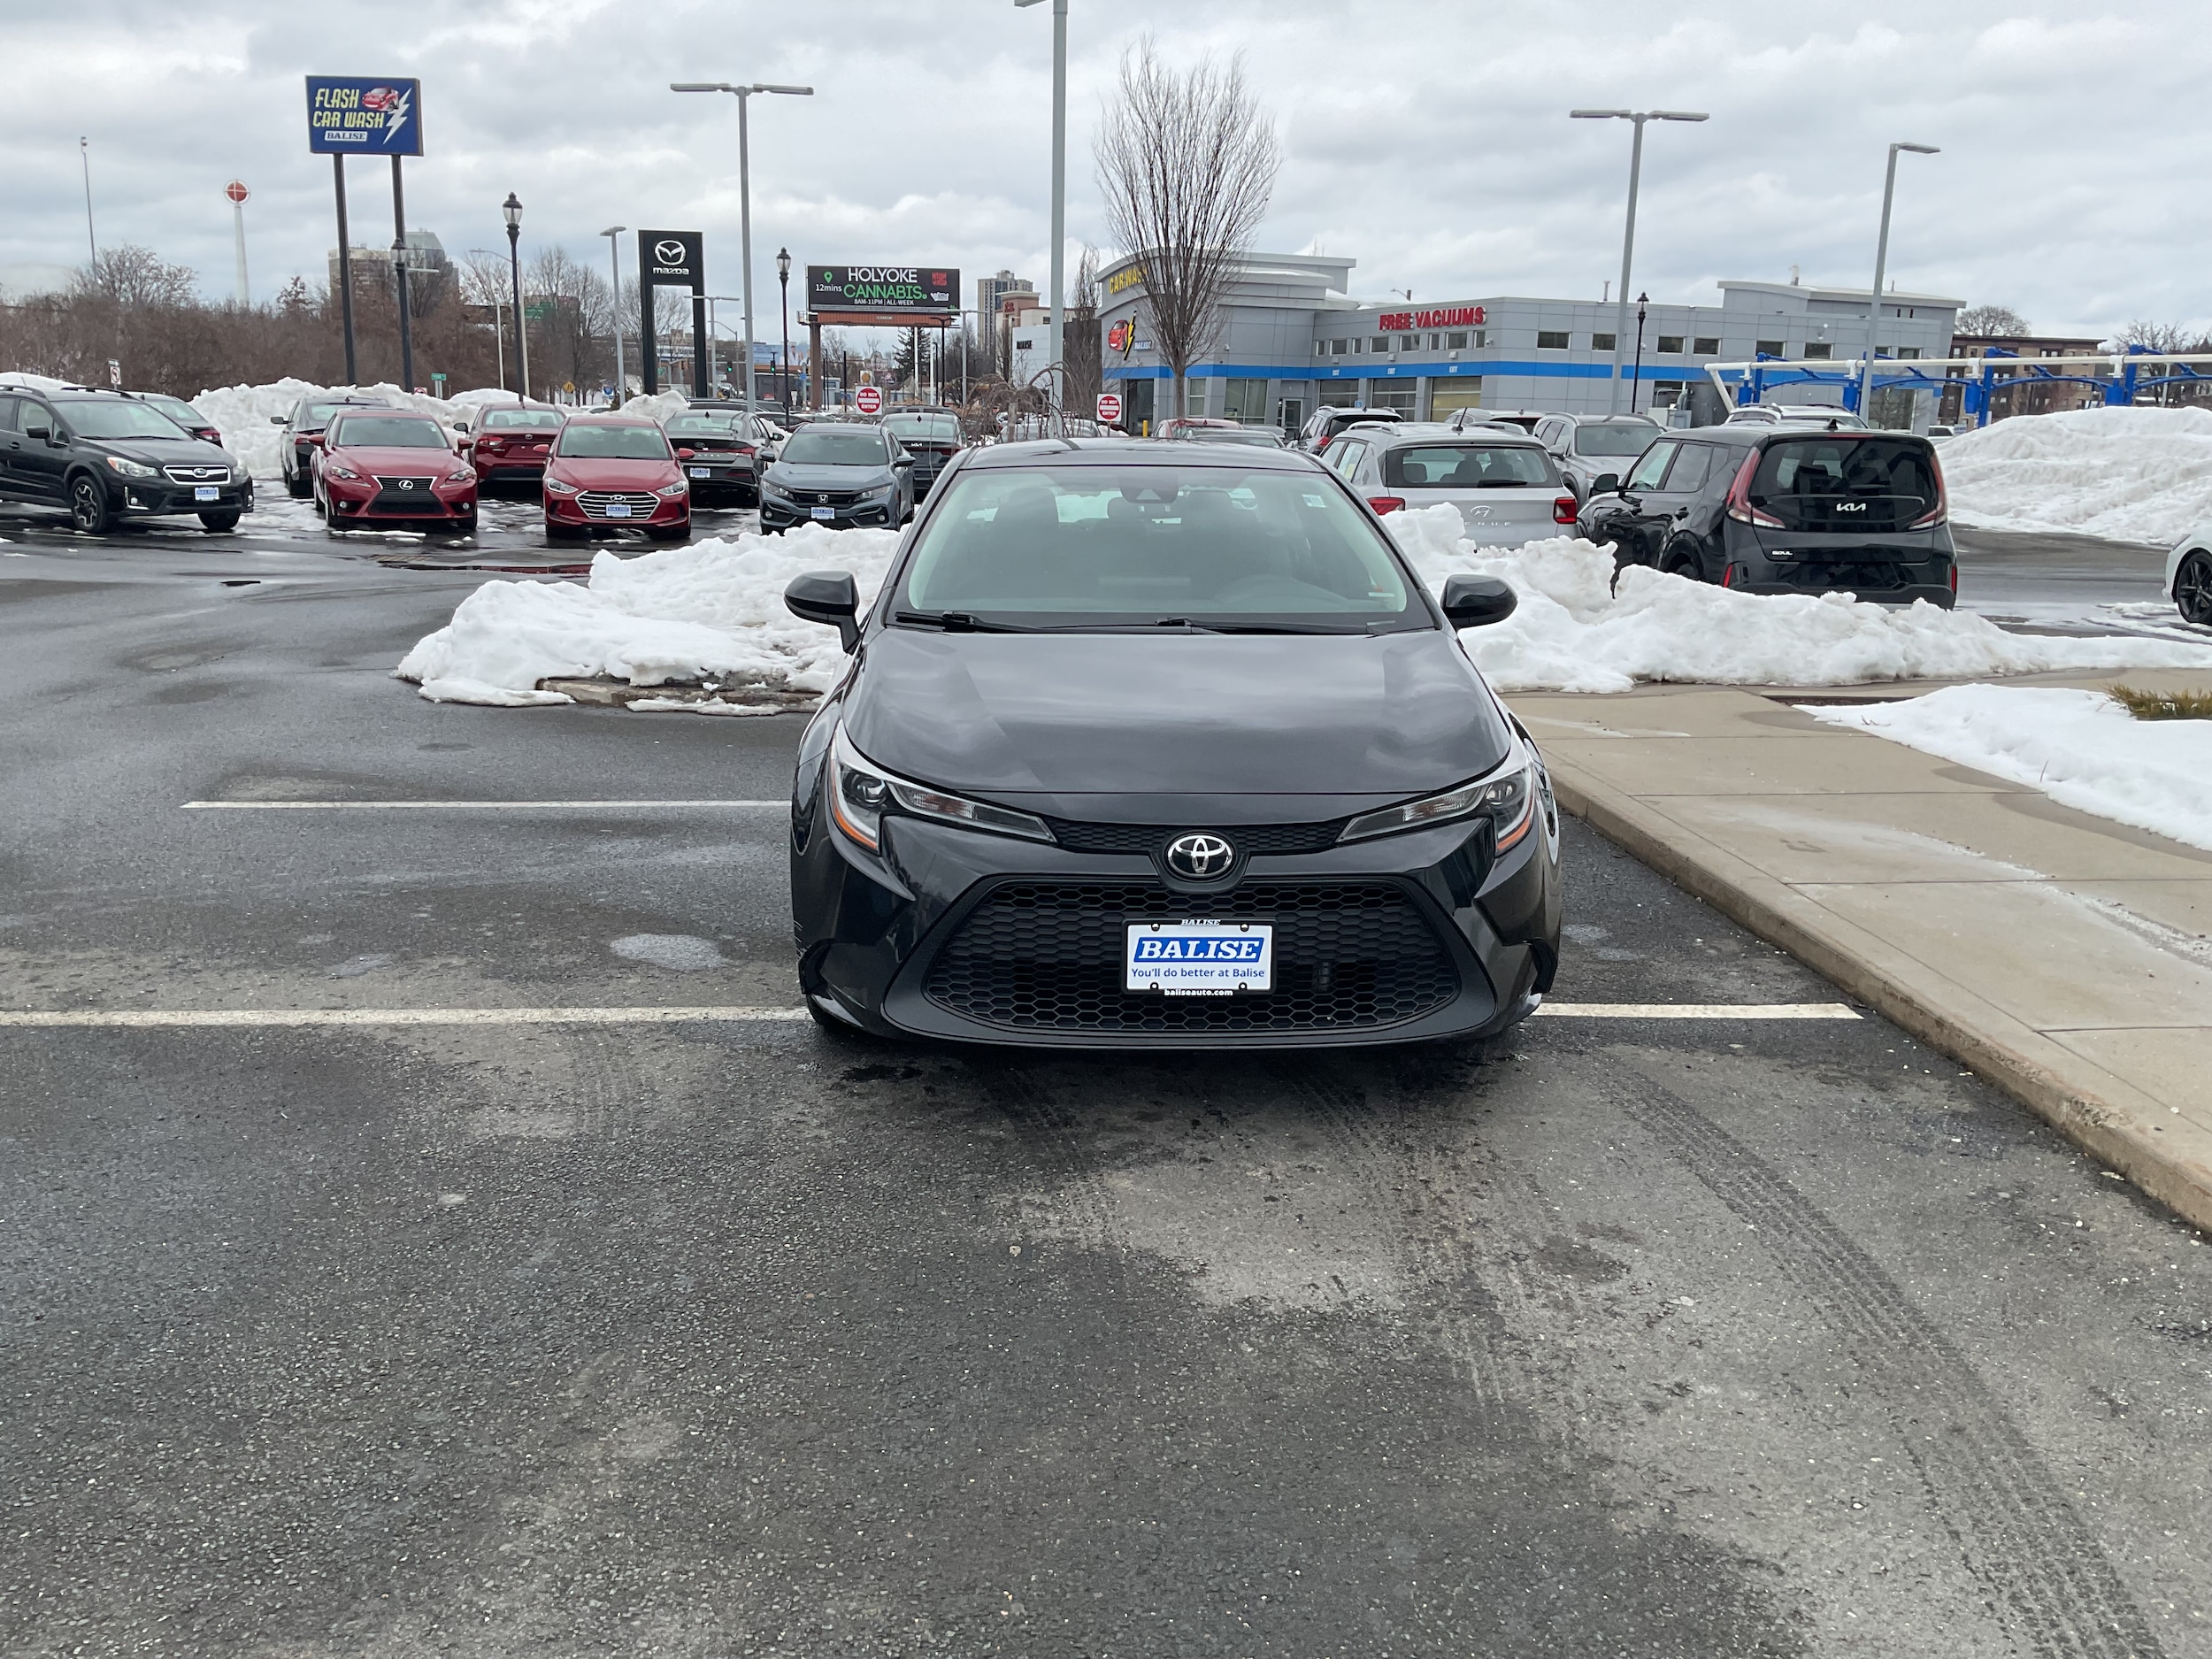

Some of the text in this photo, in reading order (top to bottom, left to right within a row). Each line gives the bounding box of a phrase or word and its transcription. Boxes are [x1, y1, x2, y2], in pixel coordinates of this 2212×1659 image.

[315, 88, 360, 108] FLASH
[312, 111, 384, 128] CAR WASH
[326, 132, 366, 141] BALISE
[848, 267, 918, 283] HOLYOKE
[815, 283, 842, 292] 12mins
[1110, 273, 1124, 295] CAR
[1379, 306, 1486, 330] FREE VACUUMS
[1836, 503, 1867, 511] KIA
[1138, 940, 1260, 959] BALISE
[1132, 968, 1265, 978] You'll do better at Balise
